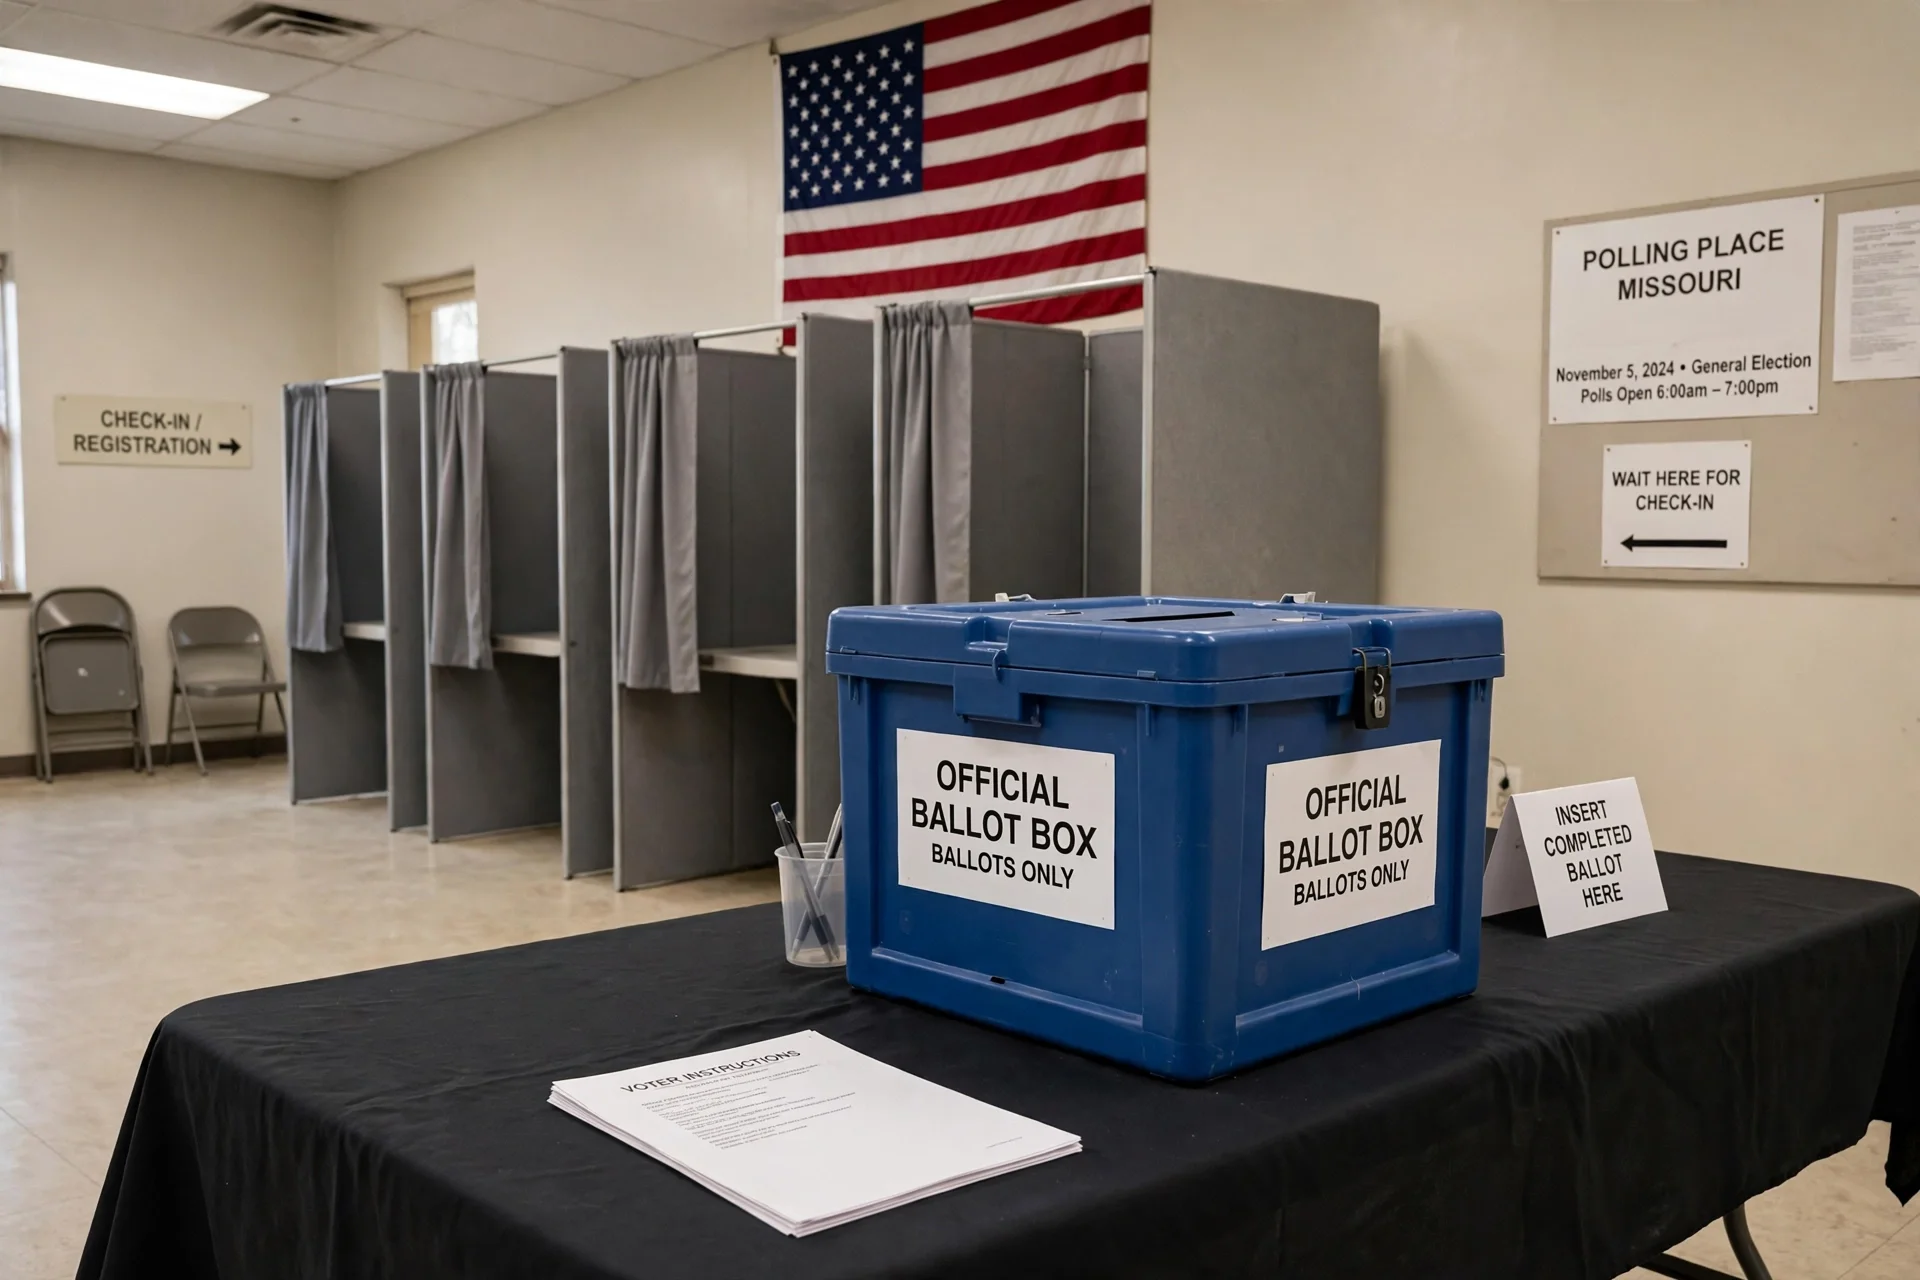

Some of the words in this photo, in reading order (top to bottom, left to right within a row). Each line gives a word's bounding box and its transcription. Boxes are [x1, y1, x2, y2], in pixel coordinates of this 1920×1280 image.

[1583, 239, 1688, 271] POLLING
[1698, 228, 1784, 259] PLACE
[1618, 268, 1741, 300] MISSOURI
[1556, 364, 1622, 383] November
[1627, 364, 1638, 381] 5,
[1642, 361, 1675, 378] 2024
[1692, 356, 1747, 374] General
[1751, 353, 1812, 371] Election
[1580, 387, 1612, 404] Polls
[1617, 386, 1652, 405] Open
[1657, 384, 1708, 399] 6:00am
[1725, 379, 1779, 397] 7:00pm
[100, 410, 190, 430] CHECK-IN
[195, 413, 202, 432] /
[73, 434, 212, 455] REGISTRATION
[1612, 471, 1651, 487] WAIT
[1656, 470, 1700, 486] HERE
[1706, 469, 1741, 486] FOR
[1636, 494, 1714, 511] CHECK-IN
[936, 760, 1070, 810] OFFICIAL
[1305, 774, 1407, 820] OFFICIAL
[911, 797, 1021, 845] BALLOT
[1032, 817, 1098, 860] BOX
[1555, 800, 1609, 826] INSERT
[1279, 824, 1372, 874] BALLOT
[1379, 814, 1424, 853] BOX
[1544, 824, 1633, 857] COMPLETED
[932, 842, 1016, 878] BALLOTS
[1021, 860, 1074, 889] ONLY
[1566, 853, 1623, 882] BALLOT
[1294, 869, 1366, 906] BALLOTS
[1371, 859, 1410, 888] ONLY
[1582, 882, 1624, 908] HERE
[620, 1076, 681, 1094] VOTER
[682, 1050, 801, 1081] INSTRUCTIONS
